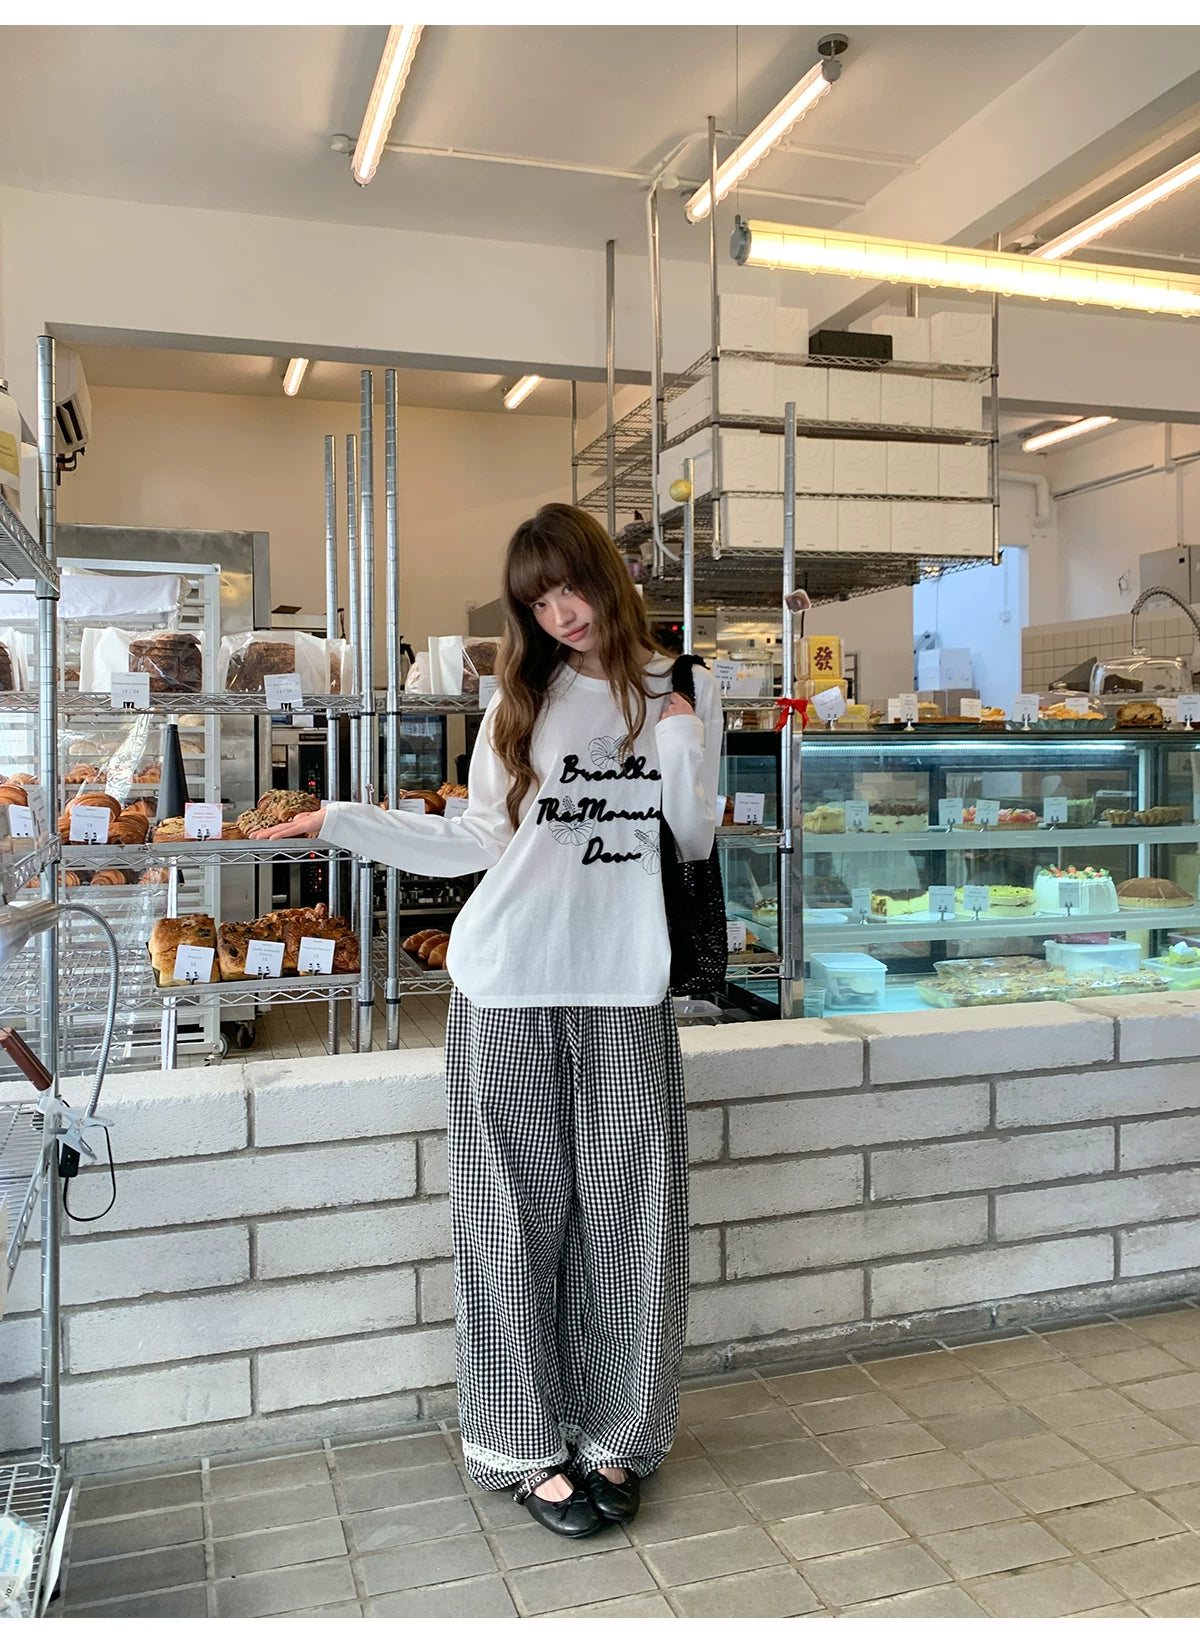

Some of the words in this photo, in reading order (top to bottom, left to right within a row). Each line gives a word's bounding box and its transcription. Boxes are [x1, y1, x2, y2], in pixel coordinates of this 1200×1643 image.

[814, 646, 833, 671] 發
[559, 754, 662, 784] Breathe
[536, 797, 579, 825] The
[582, 836, 642, 866] Dew
